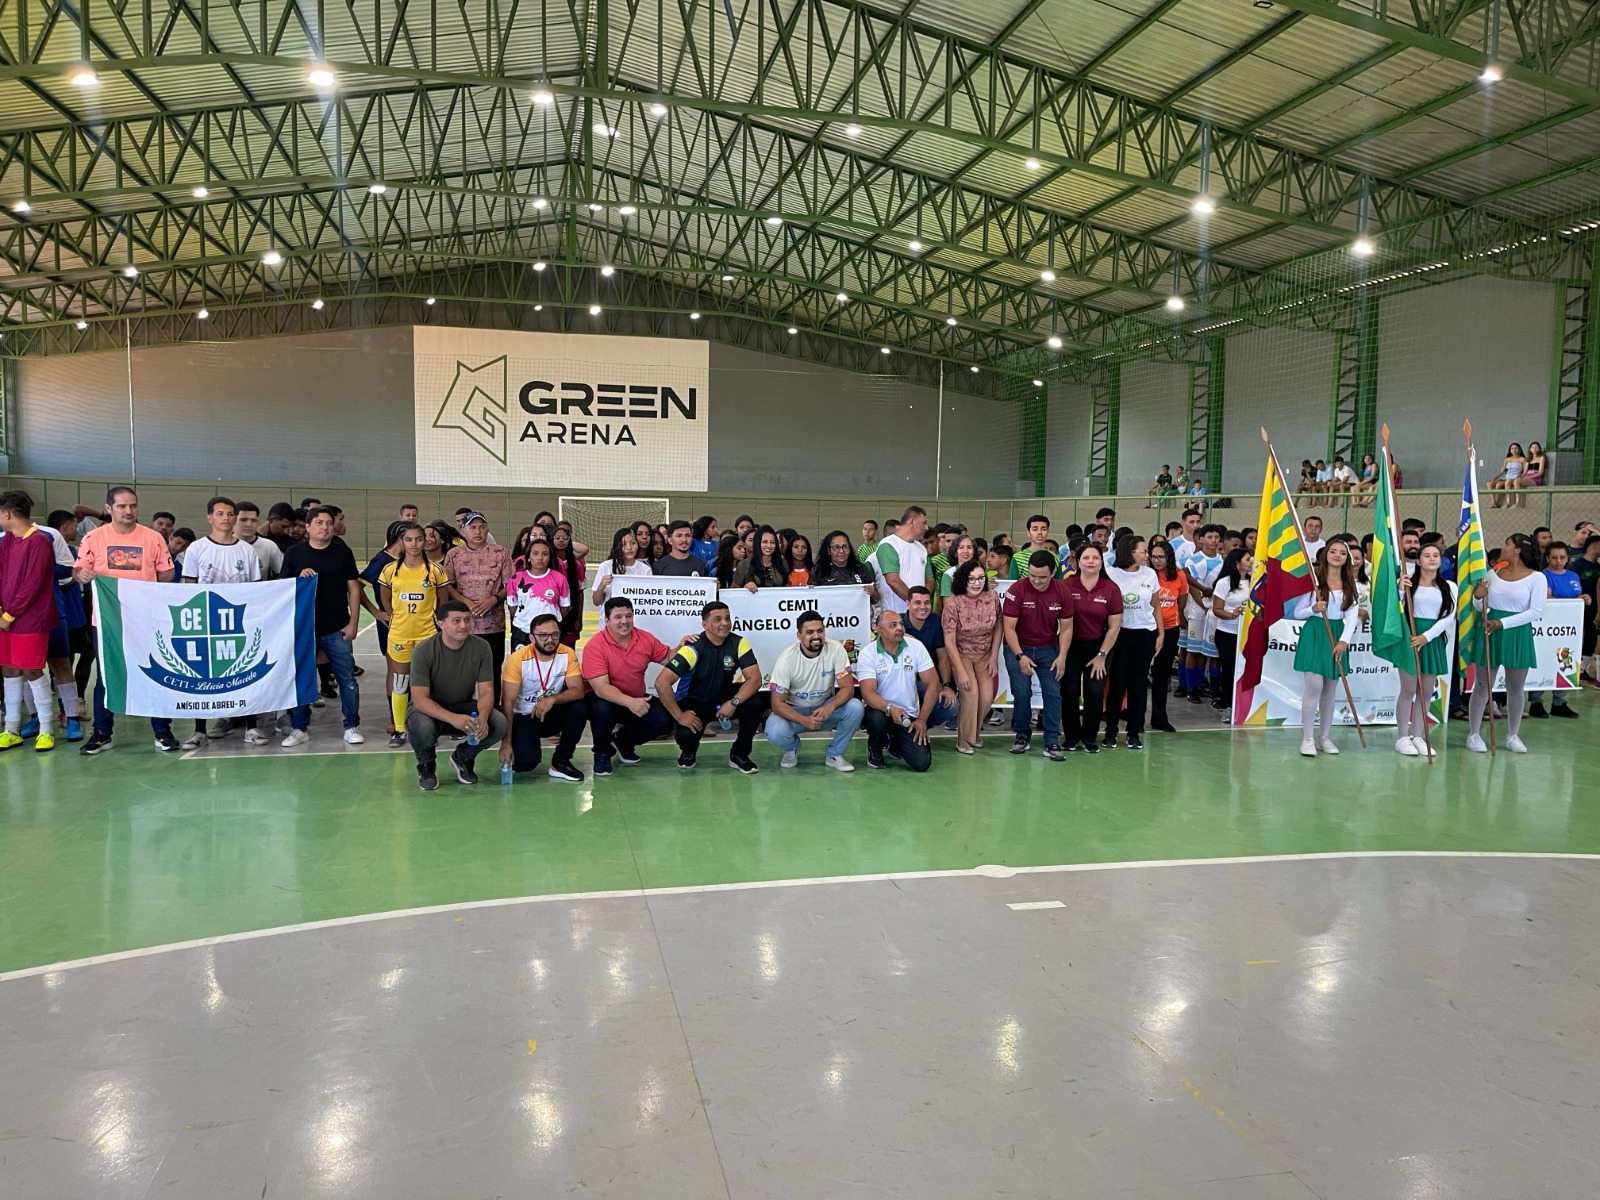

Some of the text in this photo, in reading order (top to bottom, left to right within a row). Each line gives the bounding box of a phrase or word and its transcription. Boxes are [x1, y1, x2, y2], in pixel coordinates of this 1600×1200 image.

[518, 380, 697, 420] GREEN
[519, 421, 637, 446] ARENA
[622, 588, 706, 597] UNIDADE ESCOLAR
[407, 603, 417, 614] 12
[632, 598, 664, 606] TEMPO
[778, 599, 818, 612] CEMTI
[180, 607, 235, 631] CE TI
[664, 609, 702, 617] CAPIVAR
[731, 616, 791, 632] ÂNGELO
[1546, 626, 1577, 637] COSTA
[186, 639, 237, 661] L M
[163, 675, 189, 689] CETI
[176, 701, 200, 710] ANÍSIO
[201, 702, 210, 710] DE
